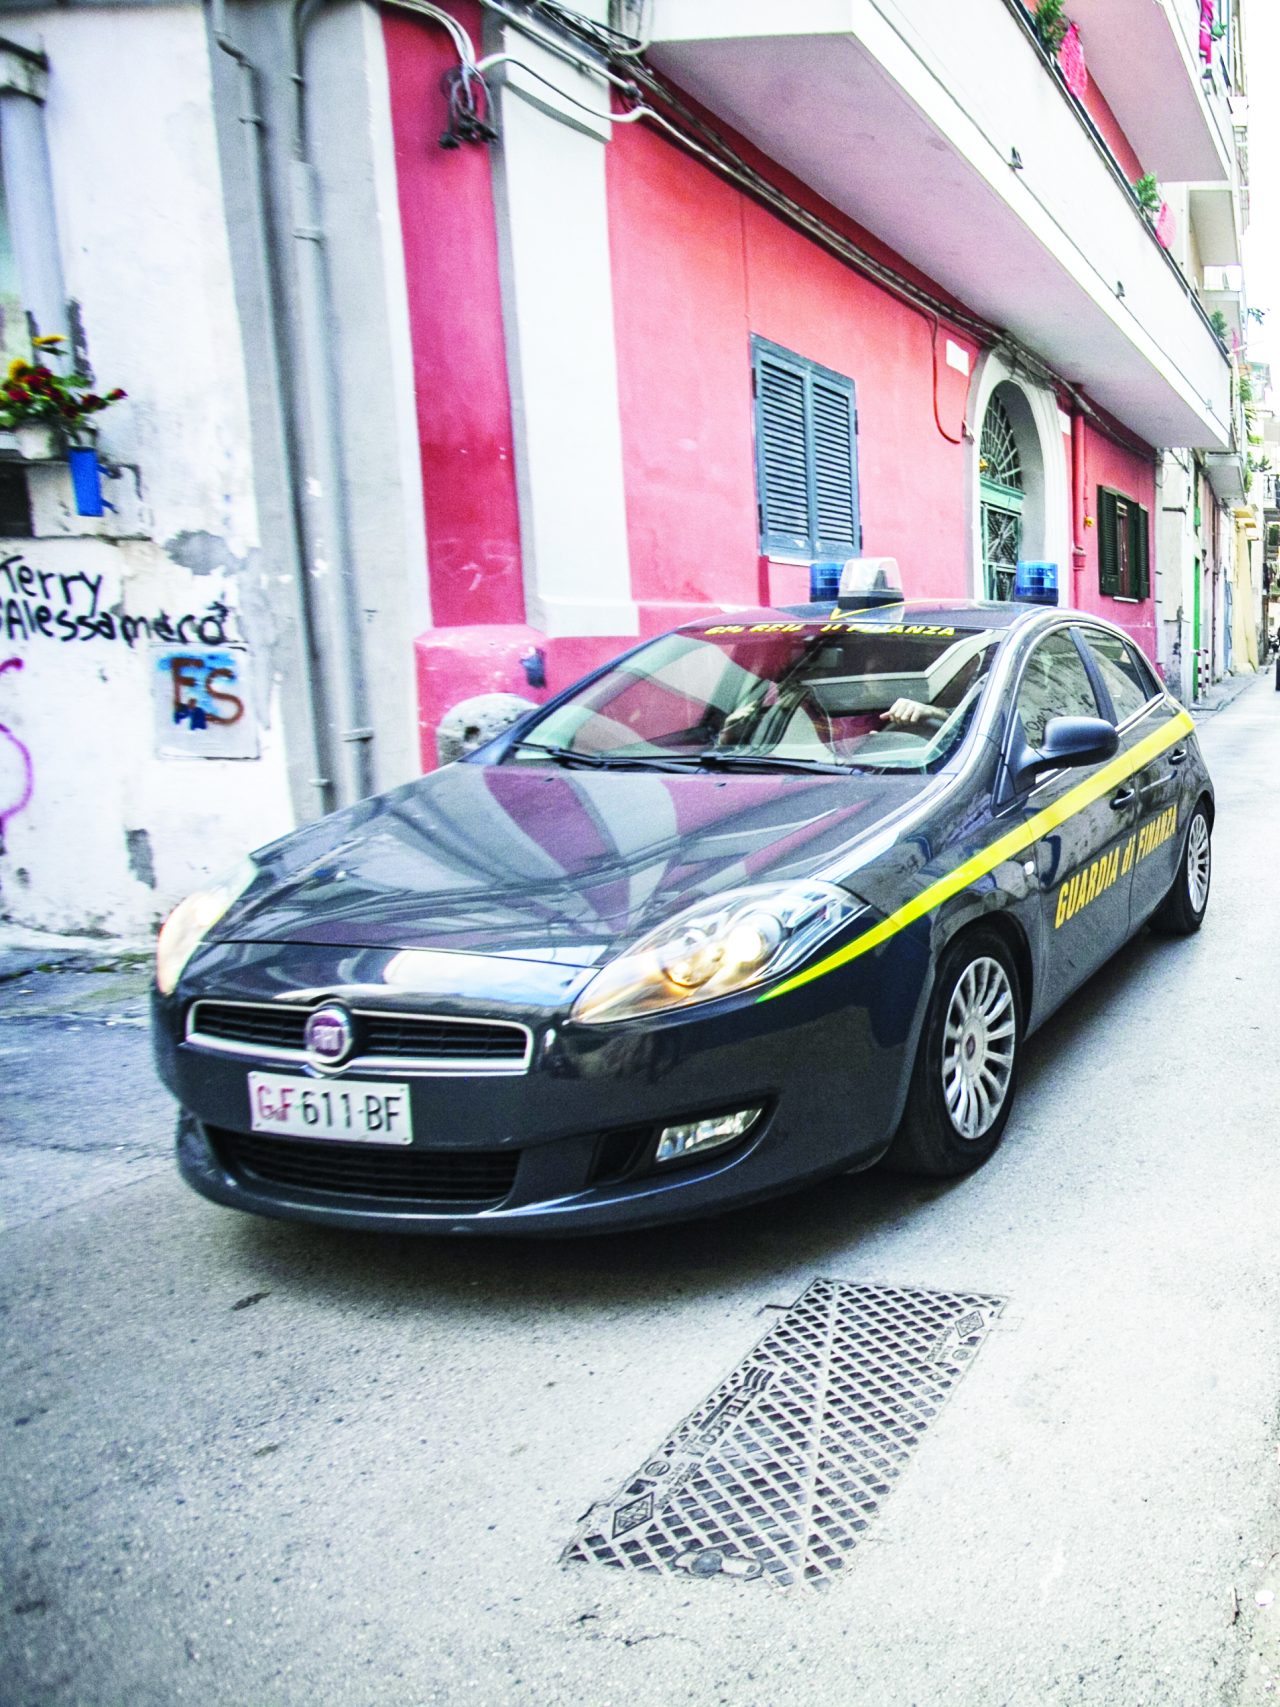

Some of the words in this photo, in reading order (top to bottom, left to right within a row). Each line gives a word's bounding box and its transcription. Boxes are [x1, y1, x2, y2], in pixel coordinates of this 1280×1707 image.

[0, 554, 103, 618] Terry
[1054, 846, 1121, 930] GUARDIA
[1120, 834, 1137, 877] di
[1135, 803, 1178, 866] FINANZA
